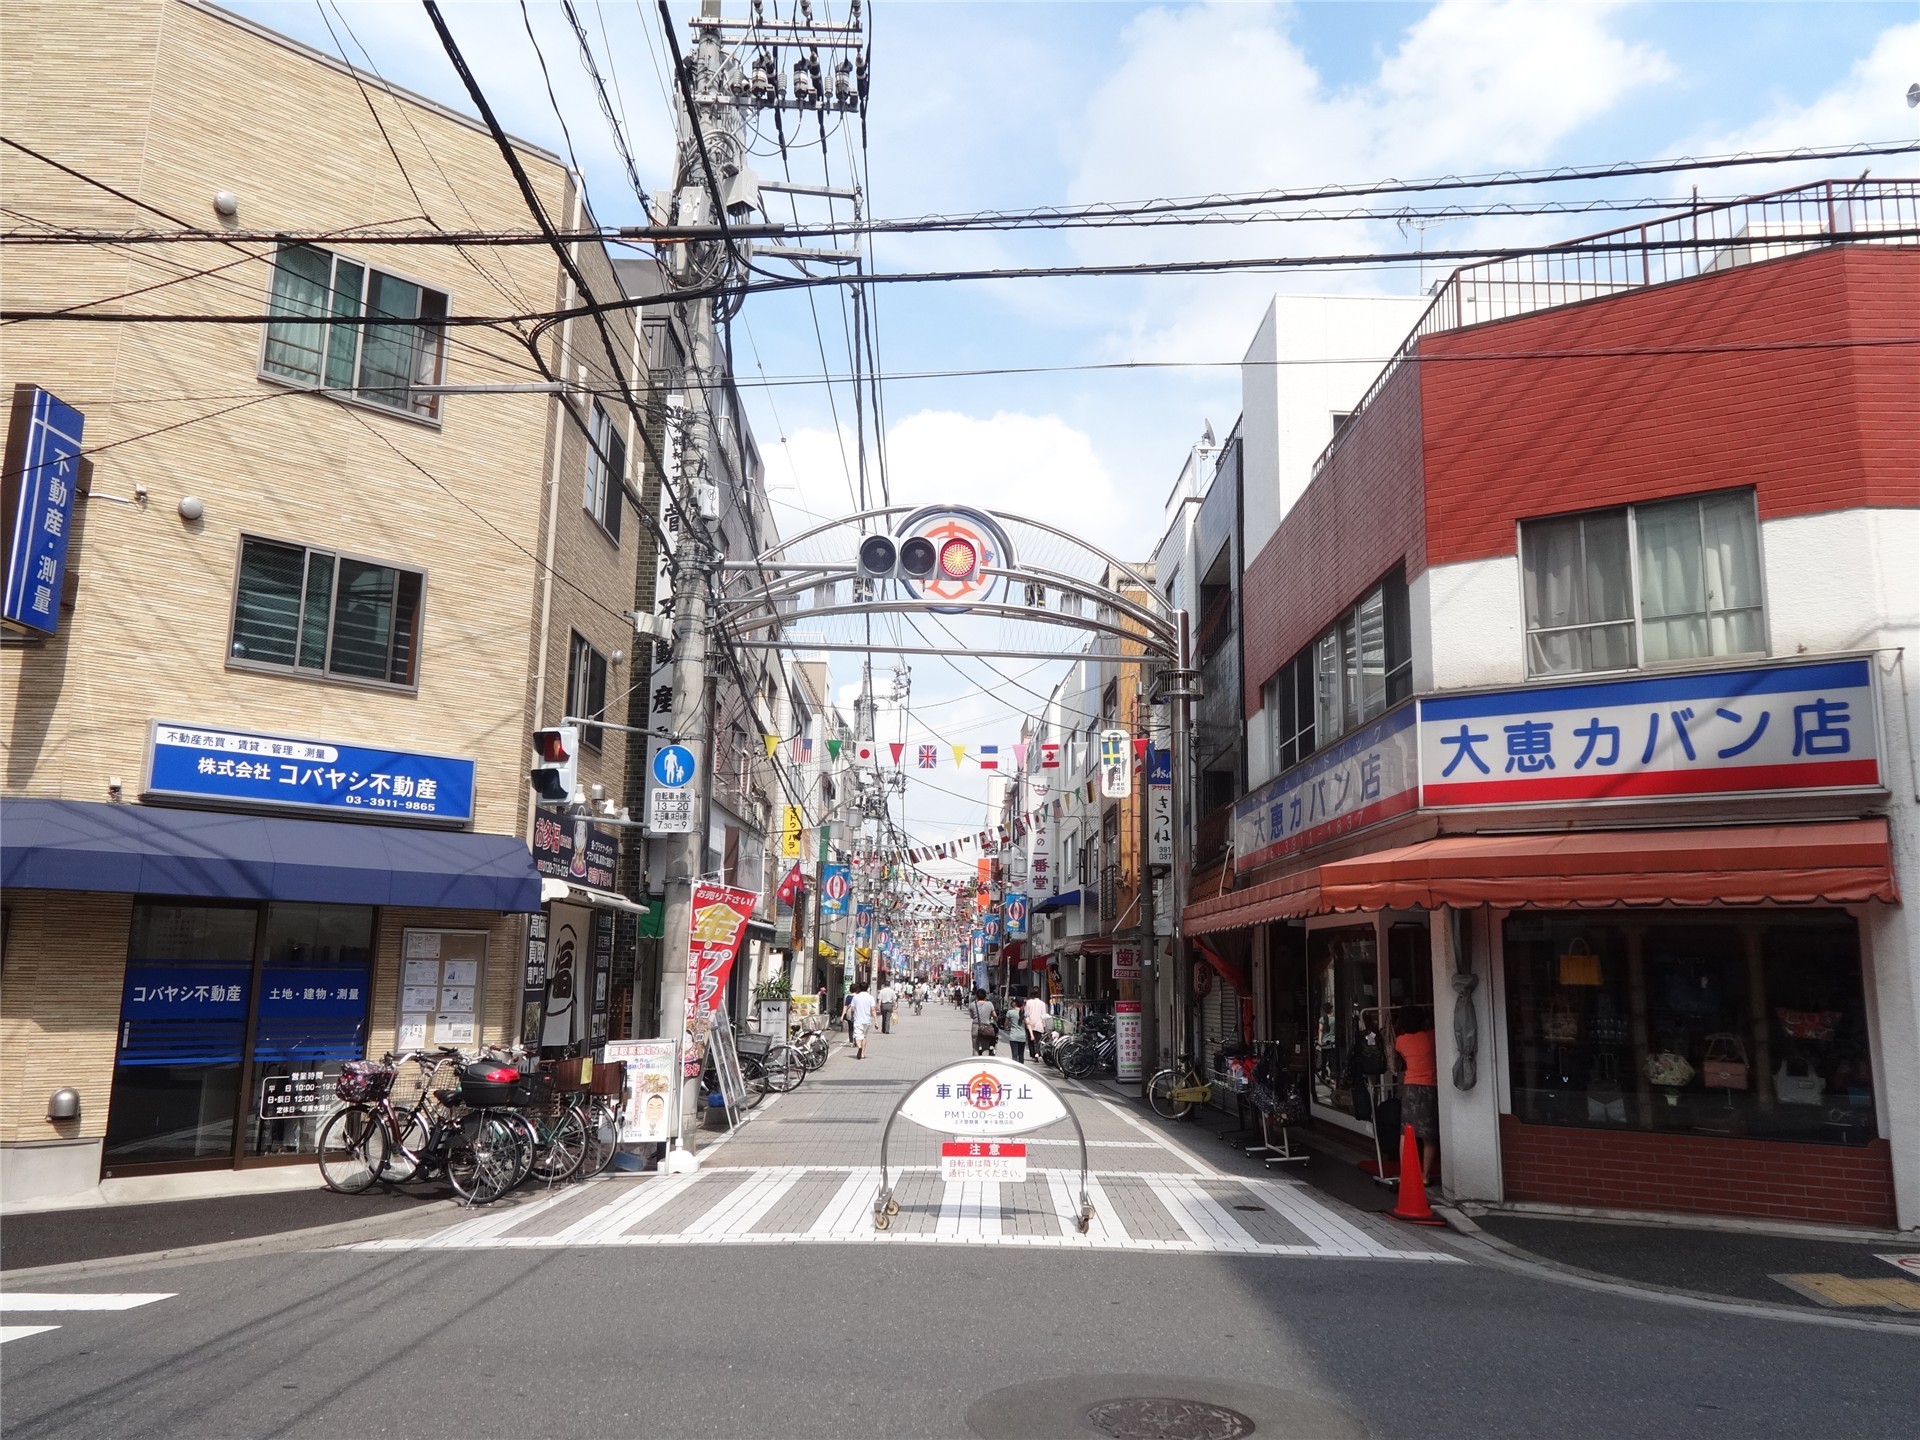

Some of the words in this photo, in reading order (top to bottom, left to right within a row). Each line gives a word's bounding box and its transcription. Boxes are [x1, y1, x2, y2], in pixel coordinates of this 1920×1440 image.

[32, 447, 71, 615] 不動産・測量
[167, 731, 326, 760] 不動産売買・賃貸・管理・測量
[1440, 698, 1850, 778] 大恵カバン店
[197, 756, 271, 781] 株式会社
[278, 763, 438, 800] コバヤシ不動産
[1151, 766, 1171, 780] Asa
[345, 795, 436, 811] 03-3911-9865
[654, 792, 692, 801] 自転車を除く
[1254, 753, 1381, 848] 大恵カバン店
[1154, 795, 1171, 843] きつね
[534, 817, 561, 854] お多福
[529, 914, 548, 938] 高価
[528, 941, 546, 964] 買取
[133, 984, 242, 1003] コバヤシ不動産
[269, 987, 360, 1000] 土地・建物・測量
[291, 1071, 324, 1081] 営業時間
[295, 1083, 337, 1092] 10:00～19:0
[935, 1083, 1033, 1100] 車両通行止
[294, 1094, 338, 1103] 12:00～19:0
[276, 1106, 296, 1114] 定休日
[969, 1143, 1001, 1156] 注意
[949, 1159, 1009, 1168] 自転車は降りて
[949, 1169, 1022, 1178] 通行してください。
